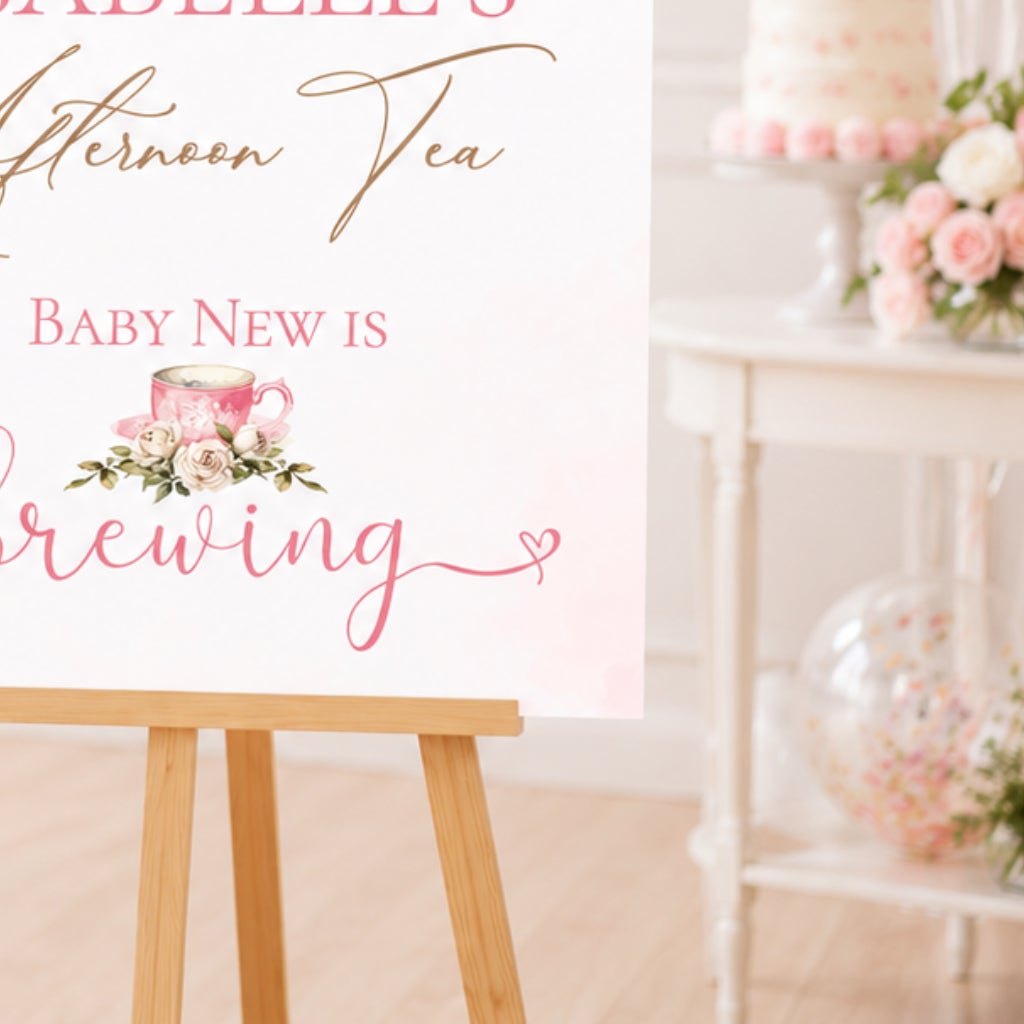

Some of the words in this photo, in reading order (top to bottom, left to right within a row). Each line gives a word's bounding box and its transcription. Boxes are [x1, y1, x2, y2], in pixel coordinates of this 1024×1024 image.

[296, 43, 557, 244] Tea
[29, 297, 174, 347] BABY
[193, 298, 326, 348] NEW
